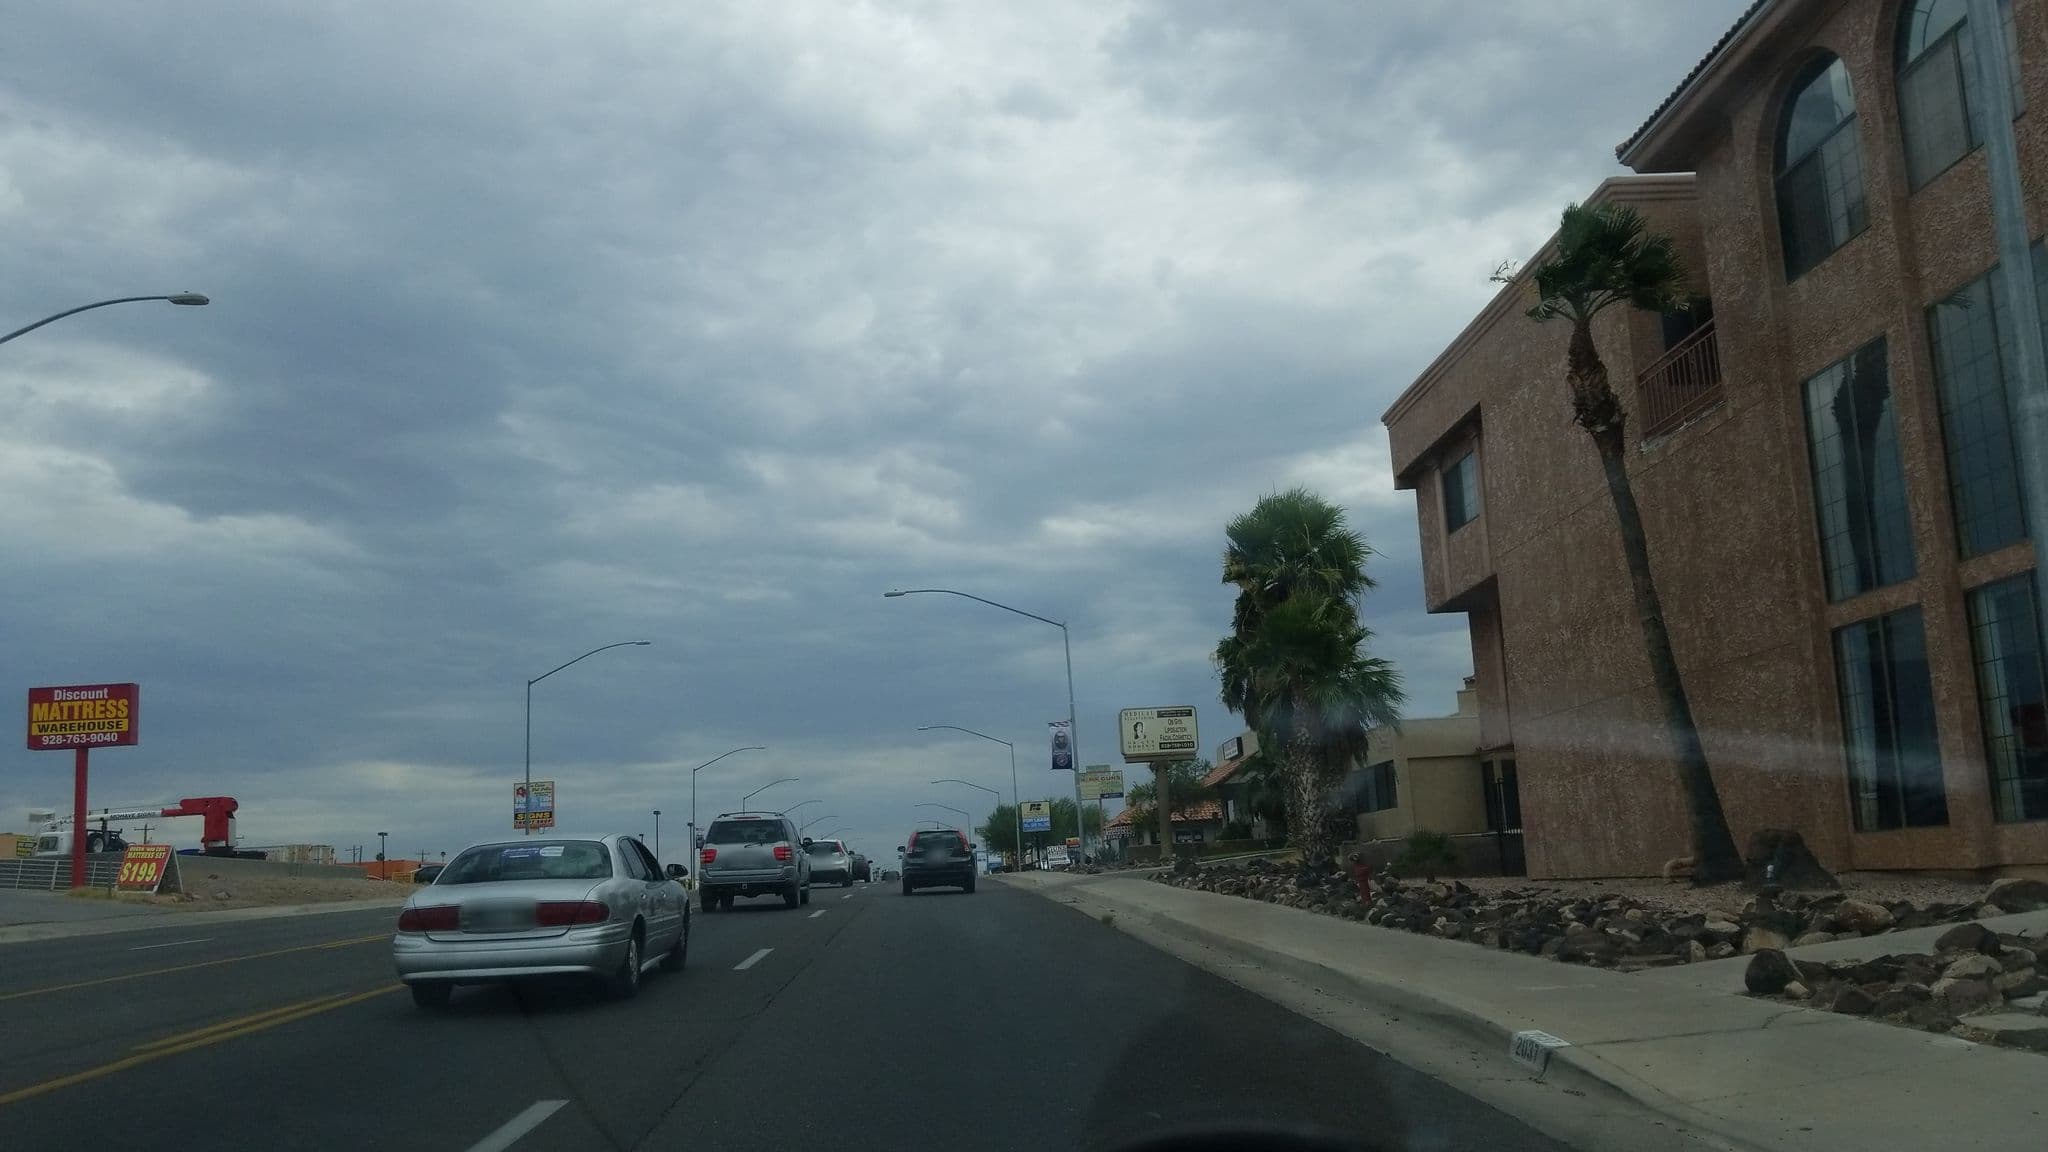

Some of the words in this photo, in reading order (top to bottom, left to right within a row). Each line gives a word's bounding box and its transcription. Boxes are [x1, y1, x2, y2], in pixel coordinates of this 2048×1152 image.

[53, 687, 109, 701] Discount
[32, 698, 129, 722] MATTRESS
[37, 720, 124, 734] WAREHOUSE
[42, 732, 118, 746] 928-763-9040
[127, 851, 155, 859] MATTRESS
